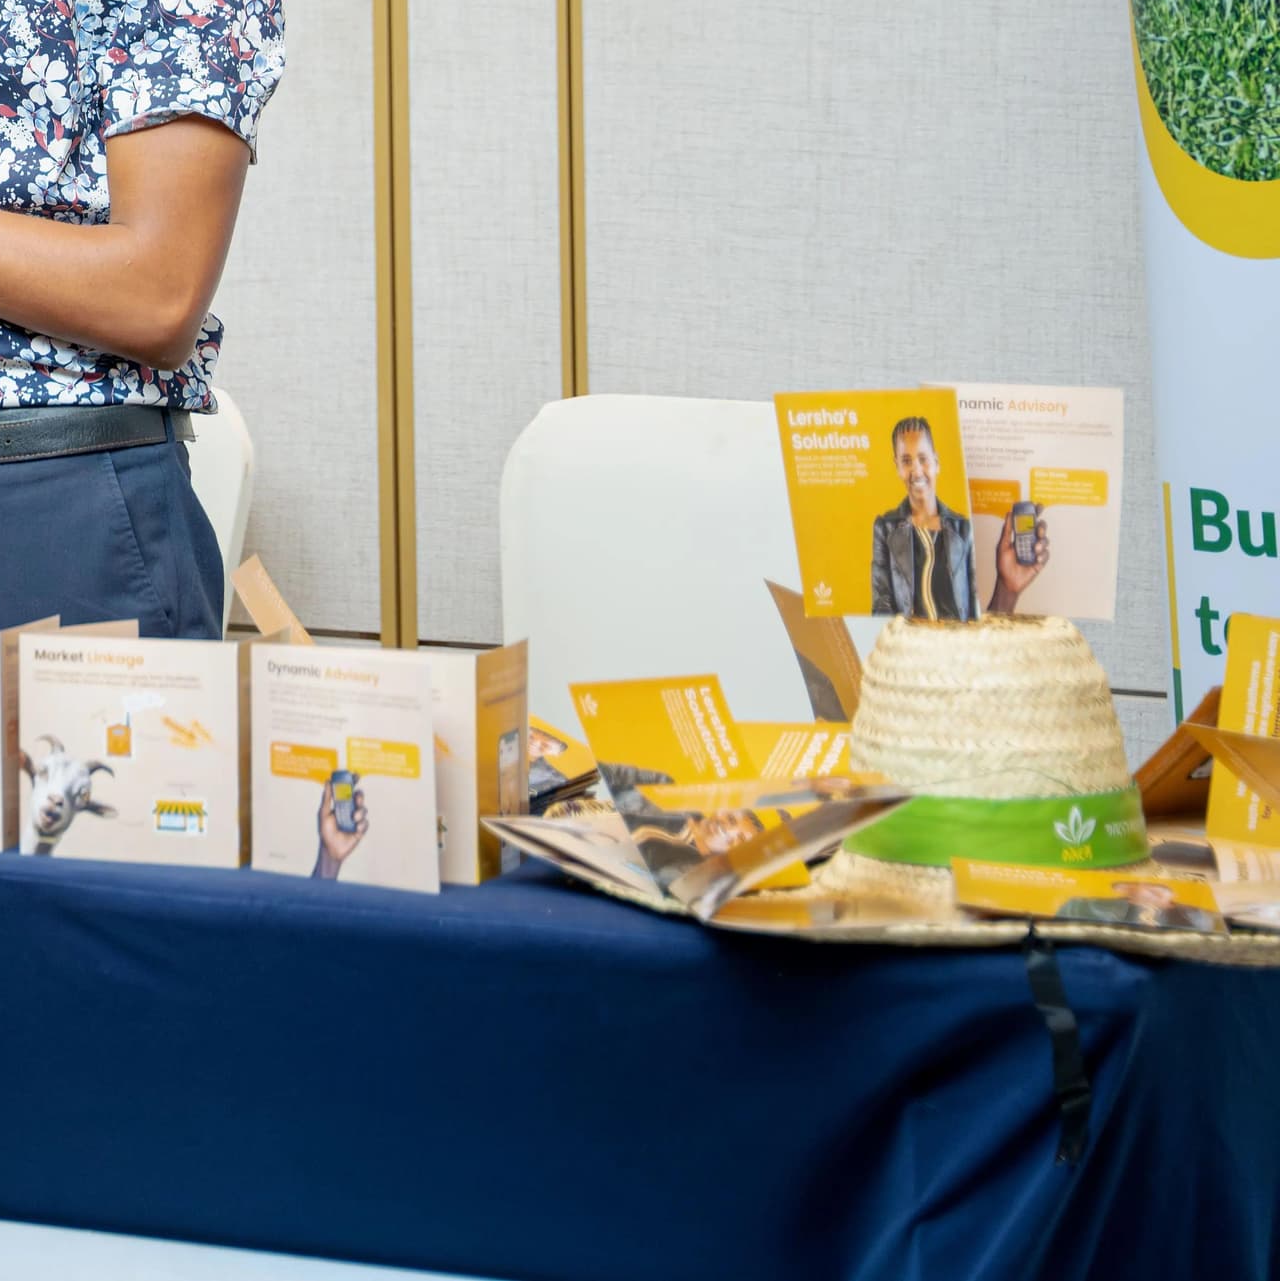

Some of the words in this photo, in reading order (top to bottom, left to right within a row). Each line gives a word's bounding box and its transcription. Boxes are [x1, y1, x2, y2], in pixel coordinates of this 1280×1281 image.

[959, 397, 1004, 411] namic
[1007, 399, 1068, 416] Advisory
[787, 408, 858, 427] Lersha's
[791, 432, 870, 450] Solutions
[1195, 596, 1230, 656] t
[34, 649, 83, 663] Market
[87, 651, 144, 669] Linkage
[268, 660, 321, 678] Dynamic
[324, 667, 379, 688] Advisory
